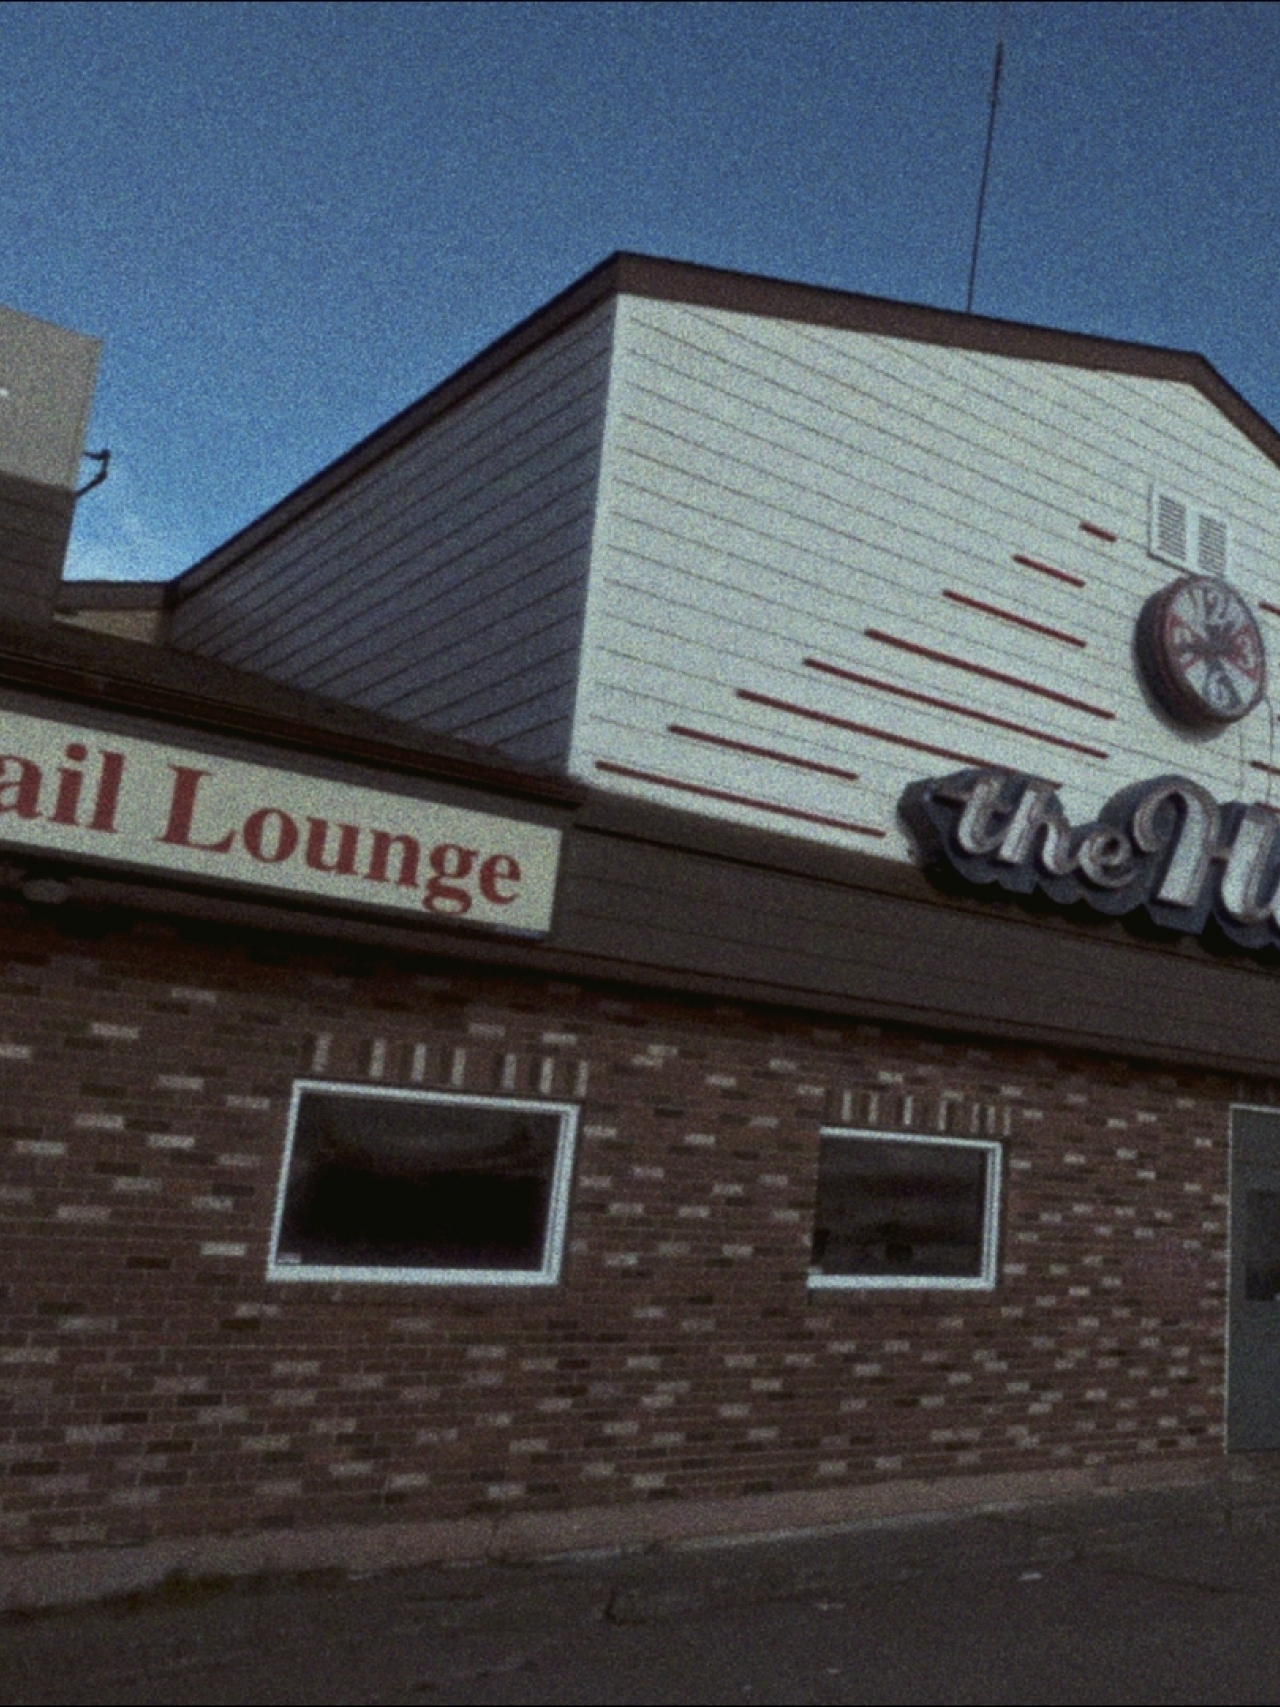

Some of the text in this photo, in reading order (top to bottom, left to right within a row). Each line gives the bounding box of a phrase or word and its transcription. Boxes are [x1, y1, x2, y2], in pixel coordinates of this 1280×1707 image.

[0, 742, 523, 916] ail Lounge
[924, 772, 1138, 890] the
